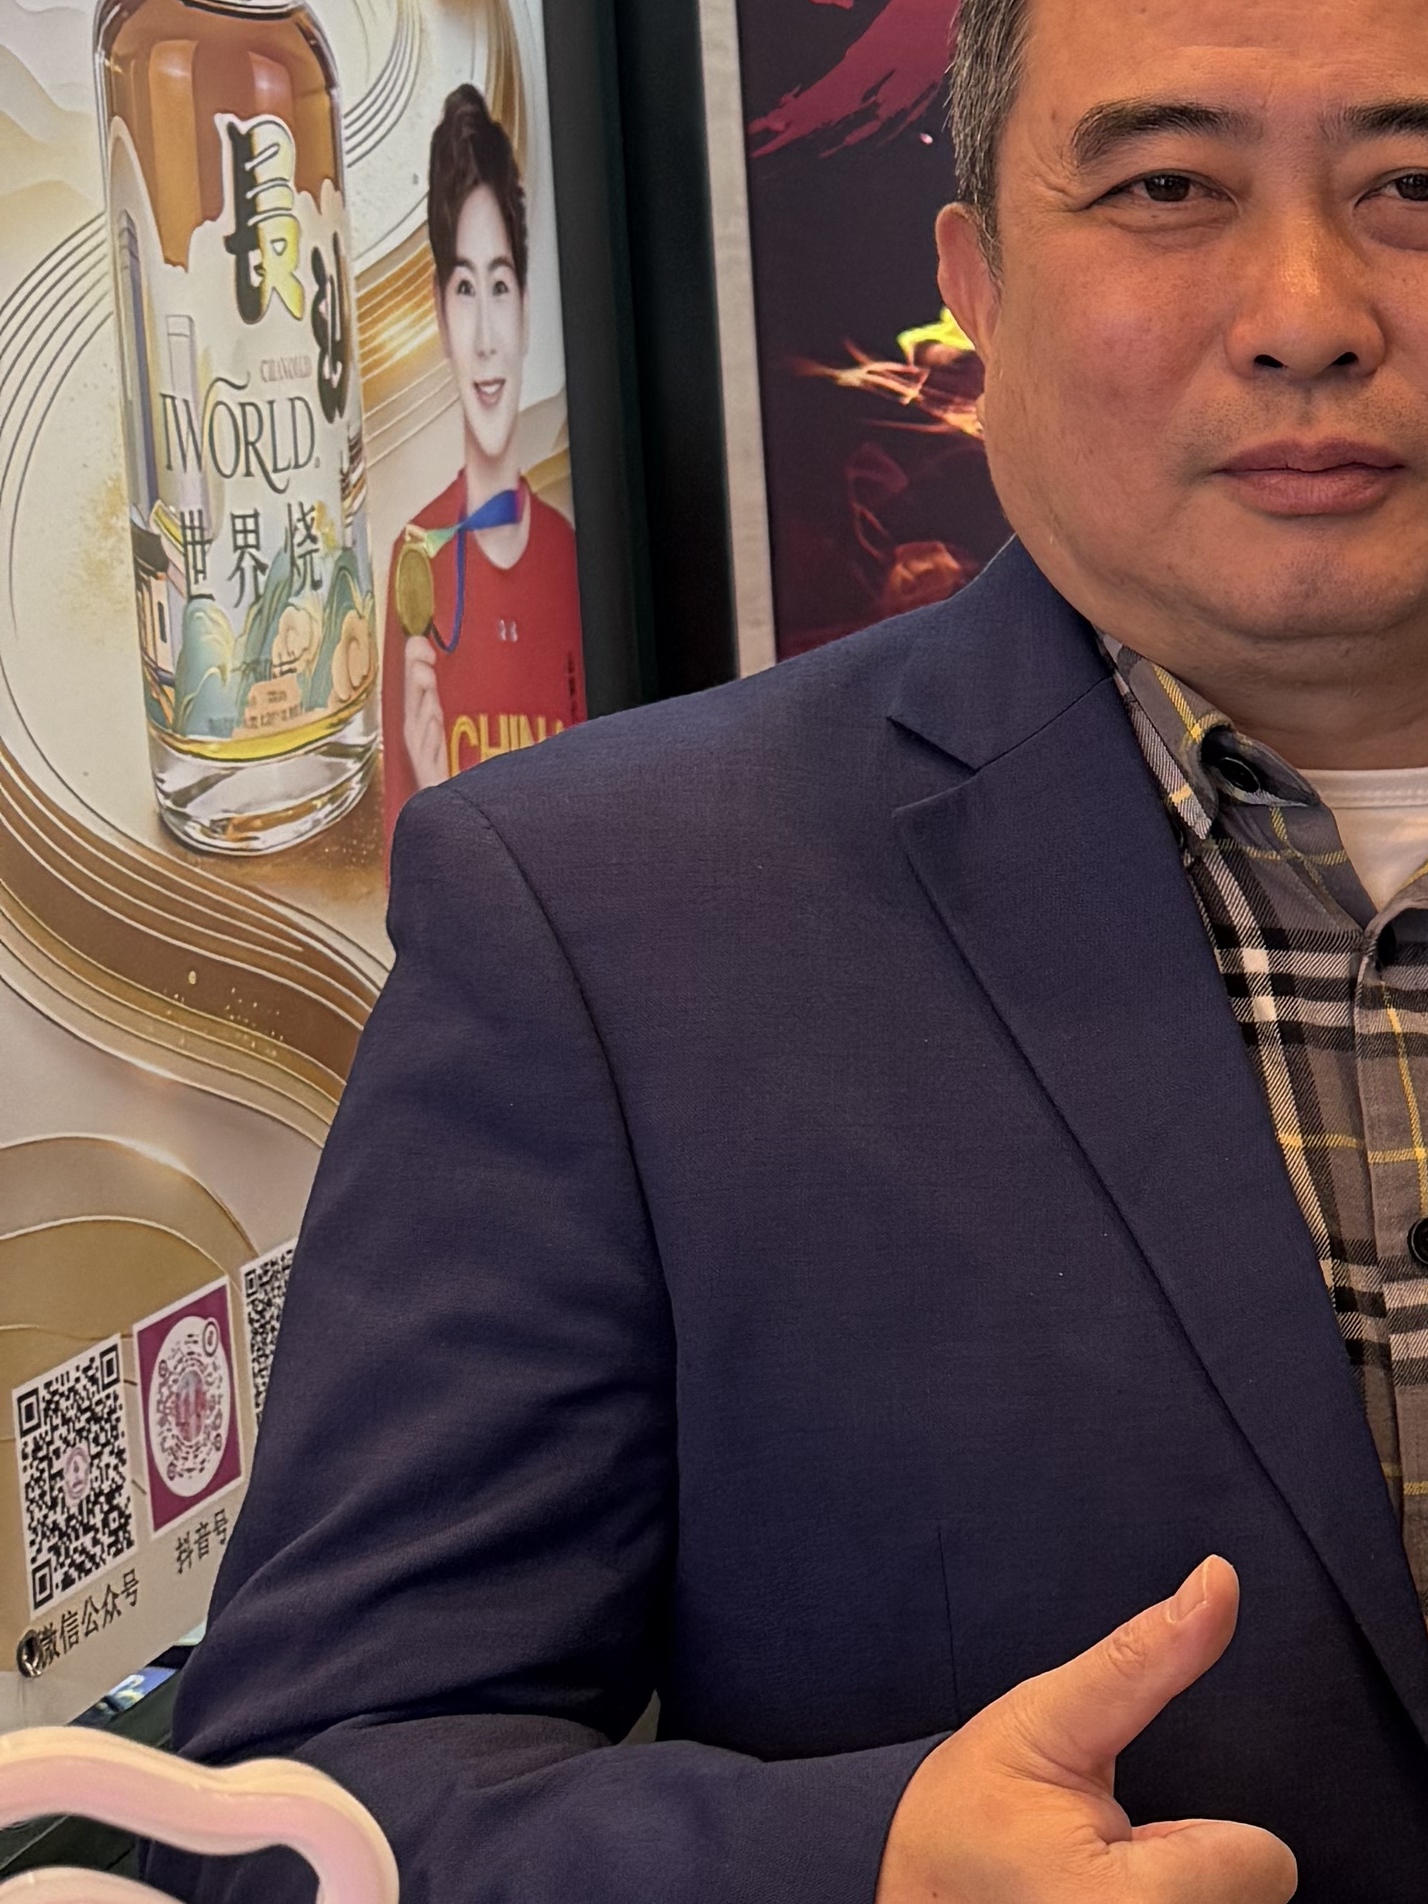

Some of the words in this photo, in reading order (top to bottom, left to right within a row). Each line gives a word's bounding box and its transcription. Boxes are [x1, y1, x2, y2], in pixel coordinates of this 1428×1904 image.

[160, 376, 317, 495] IWORLD
[180, 499, 324, 609] 世界烧
[175, 1508, 229, 1574] 抖音号
[36, 1568, 141, 1674] 微信公众号
